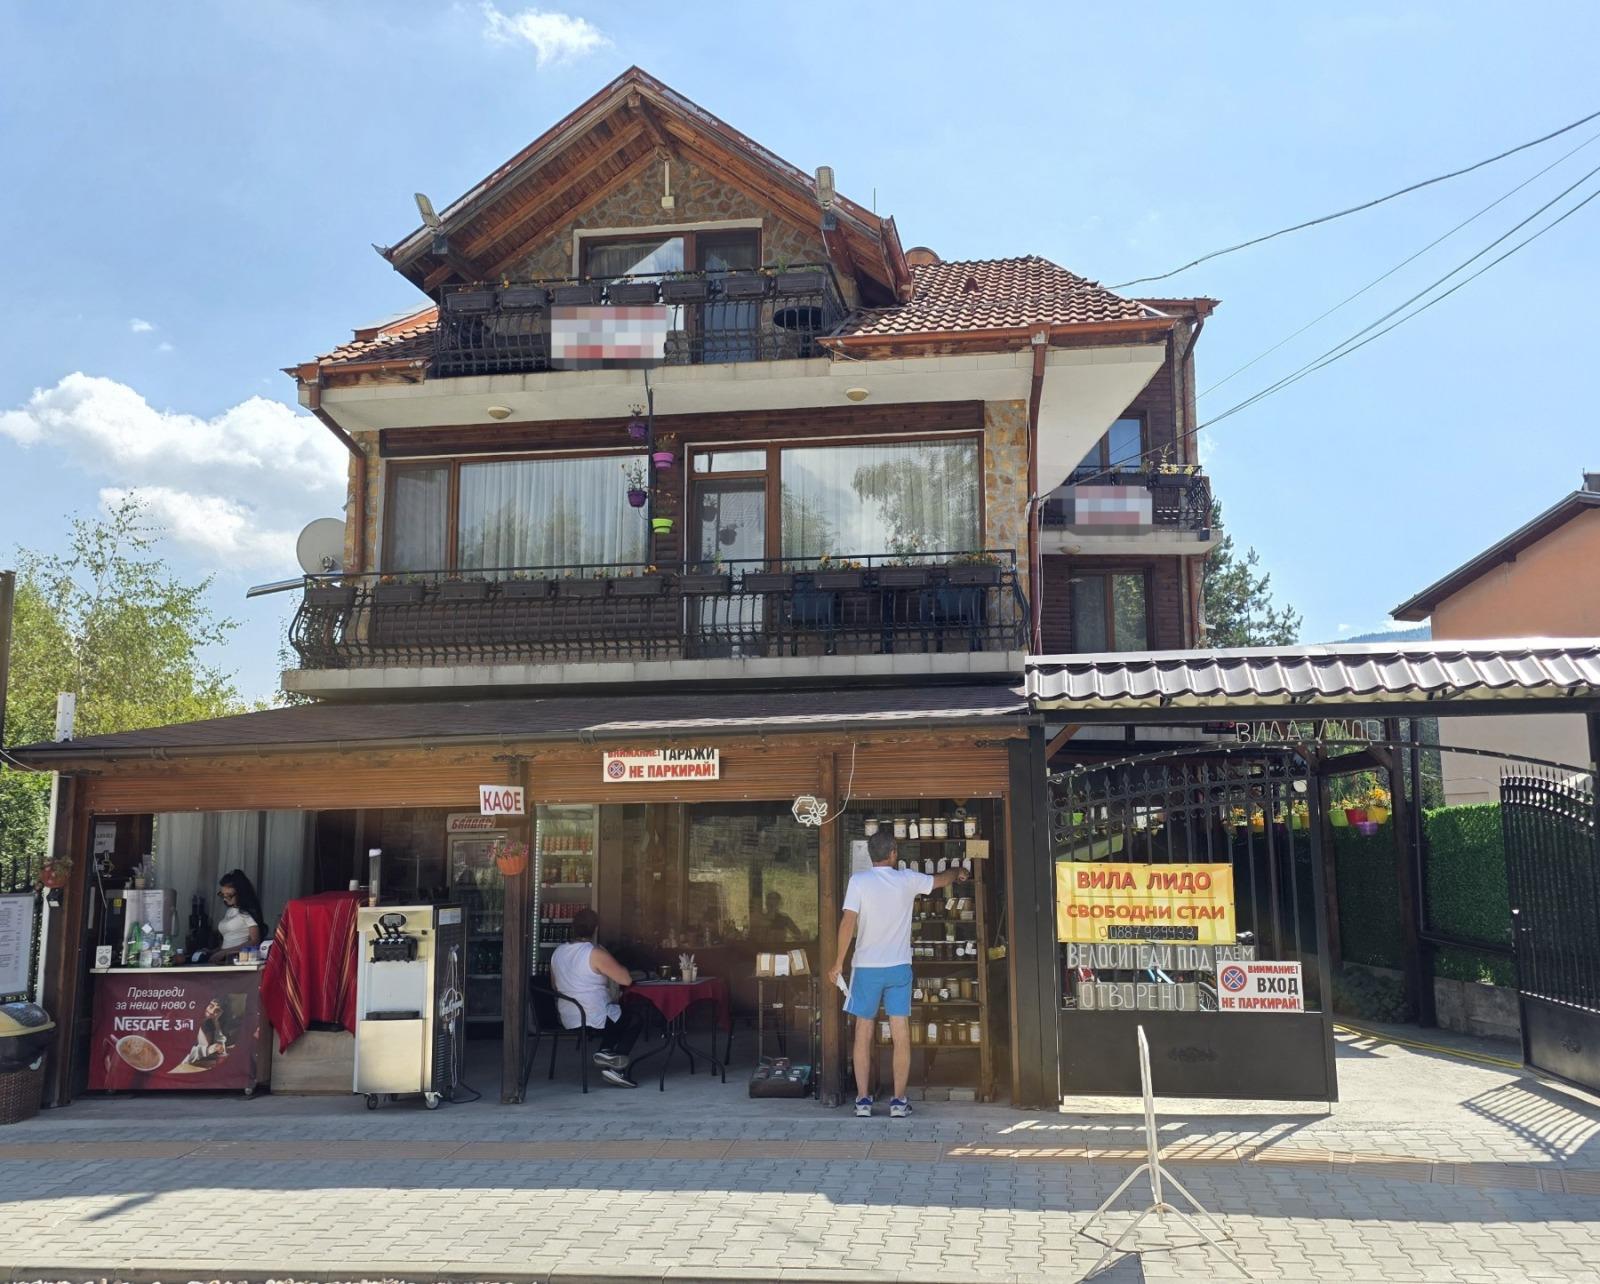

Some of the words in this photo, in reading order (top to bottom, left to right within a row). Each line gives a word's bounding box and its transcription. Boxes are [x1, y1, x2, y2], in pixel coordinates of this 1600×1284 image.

[1236, 719, 1302, 743] ВИЛА
[629, 765, 644, 778] НЕ
[648, 761, 715, 777] ПАРКИРАЙ!
[483, 789, 522, 812] КАФЕ
[1077, 871, 1137, 890] ВИЛА
[1147, 871, 1211, 893] ЛИДО
[1066, 904, 1172, 921] СВОБОДНИ
[1177, 905, 1225, 920] СТАИ
[1109, 926, 1140, 939] 0887
[1067, 943, 1172, 969] ВЕЛОСИПЕДИ
[1177, 946, 1213, 971] ПОД
[1215, 946, 1255, 962] НАЕМ
[1248, 965, 1299, 974] ВНИМАНИЕ!
[127, 986, 185, 1000] Презареди
[1257, 977, 1298, 995] ВХОД
[1081, 983, 1185, 1010] ОТВОРЕНО
[1222, 997, 1235, 1009] НЕ
[1238, 996, 1299, 1009] ПАРКИРАЙ!
[115, 1001, 127, 1010] за
[129, 1001, 158, 1011] нещо
[161, 1001, 186, 1010] ново
[188, 1001, 196, 1010] с
